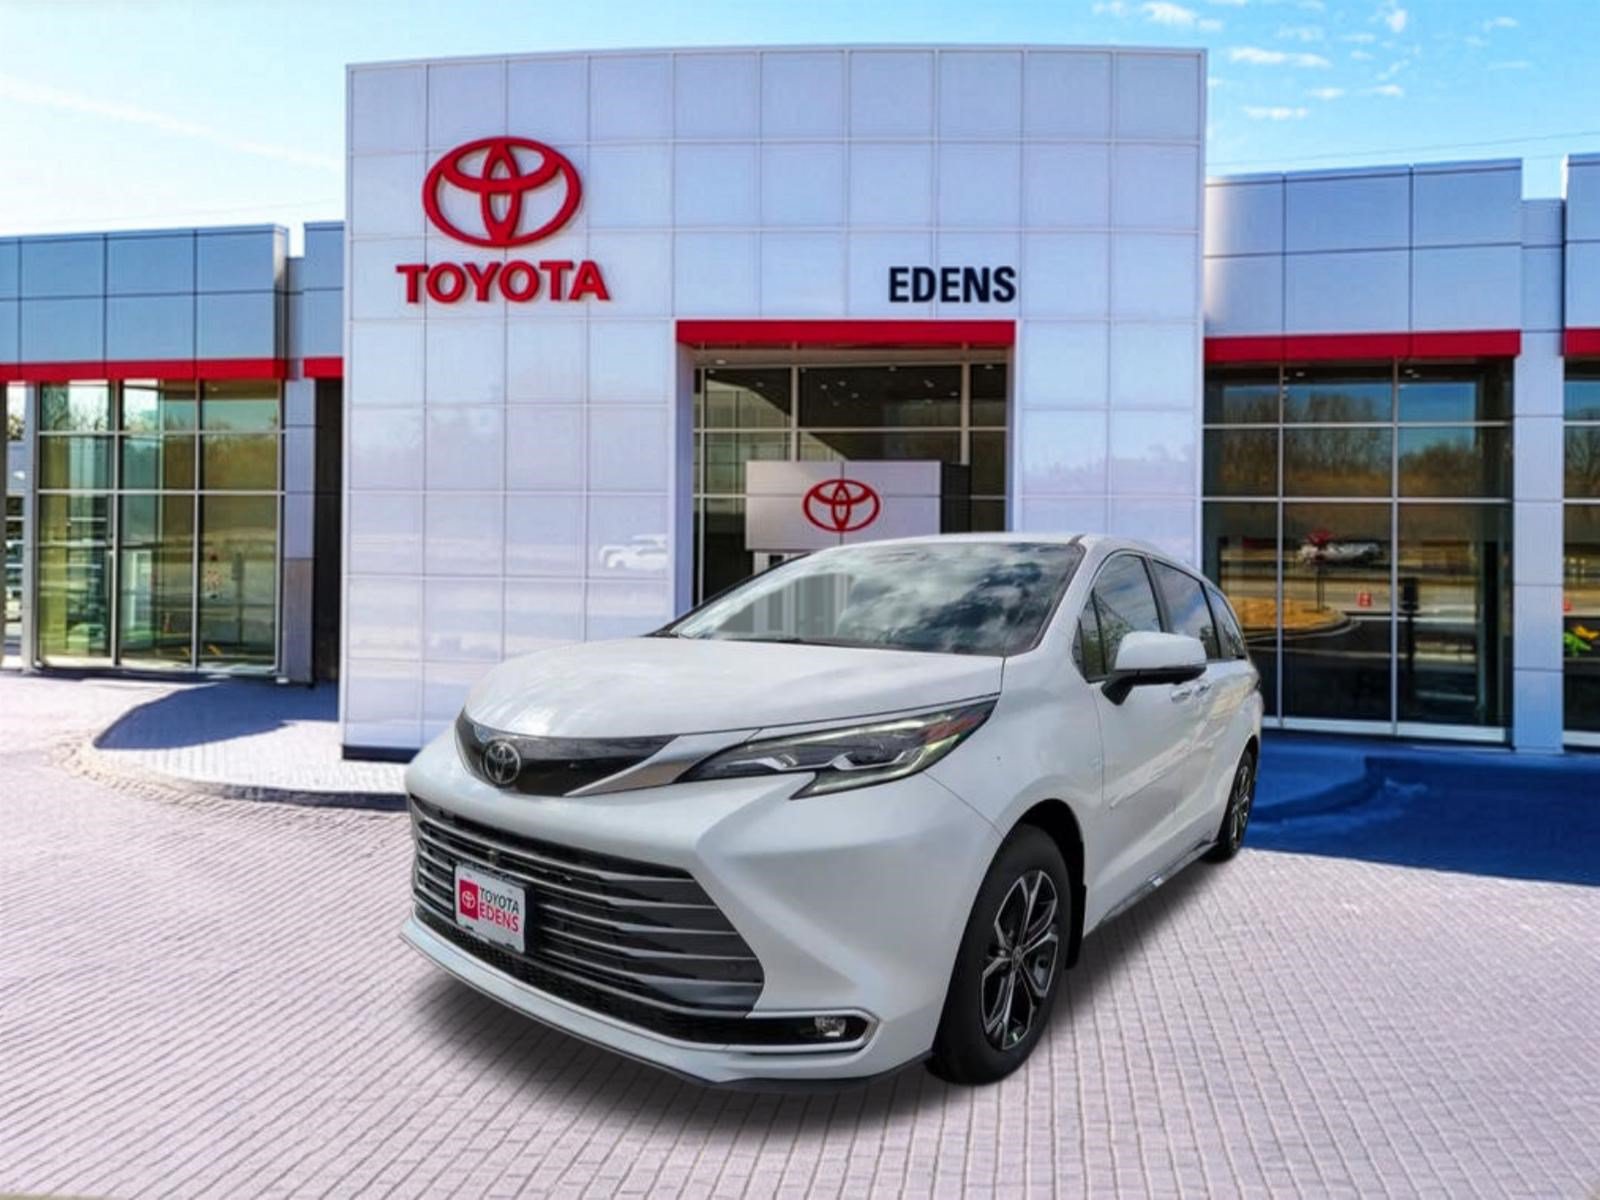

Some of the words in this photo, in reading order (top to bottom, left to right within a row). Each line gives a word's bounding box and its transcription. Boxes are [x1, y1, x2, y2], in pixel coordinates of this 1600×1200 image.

[396, 260, 611, 303] TOYOTA
[889, 266, 1016, 303] EDENS
[480, 887, 519, 914] TOYOTA
[480, 902, 519, 932] EDENS
